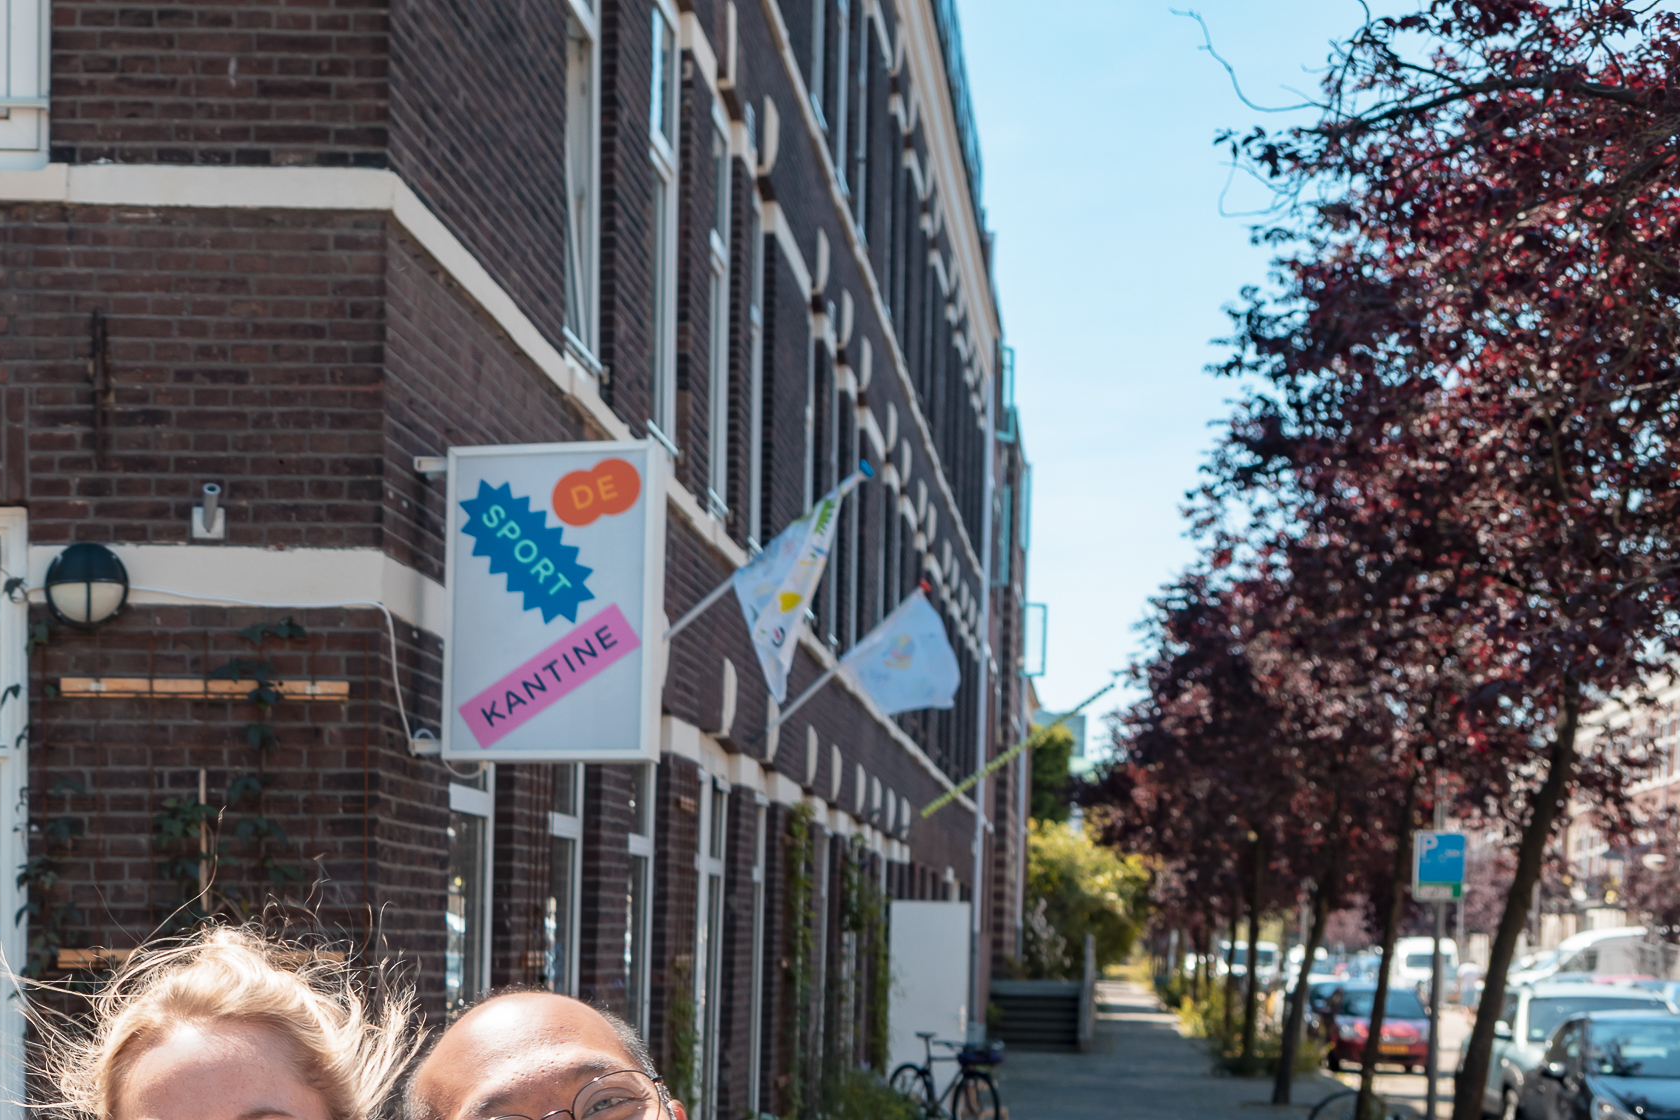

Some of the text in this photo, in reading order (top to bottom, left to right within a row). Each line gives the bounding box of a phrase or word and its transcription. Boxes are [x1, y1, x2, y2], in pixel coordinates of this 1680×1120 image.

[571, 475, 619, 510] DE
[482, 504, 573, 596] SPORT
[480, 625, 619, 728] KANTINE
[1420, 834, 1439, 858] P
